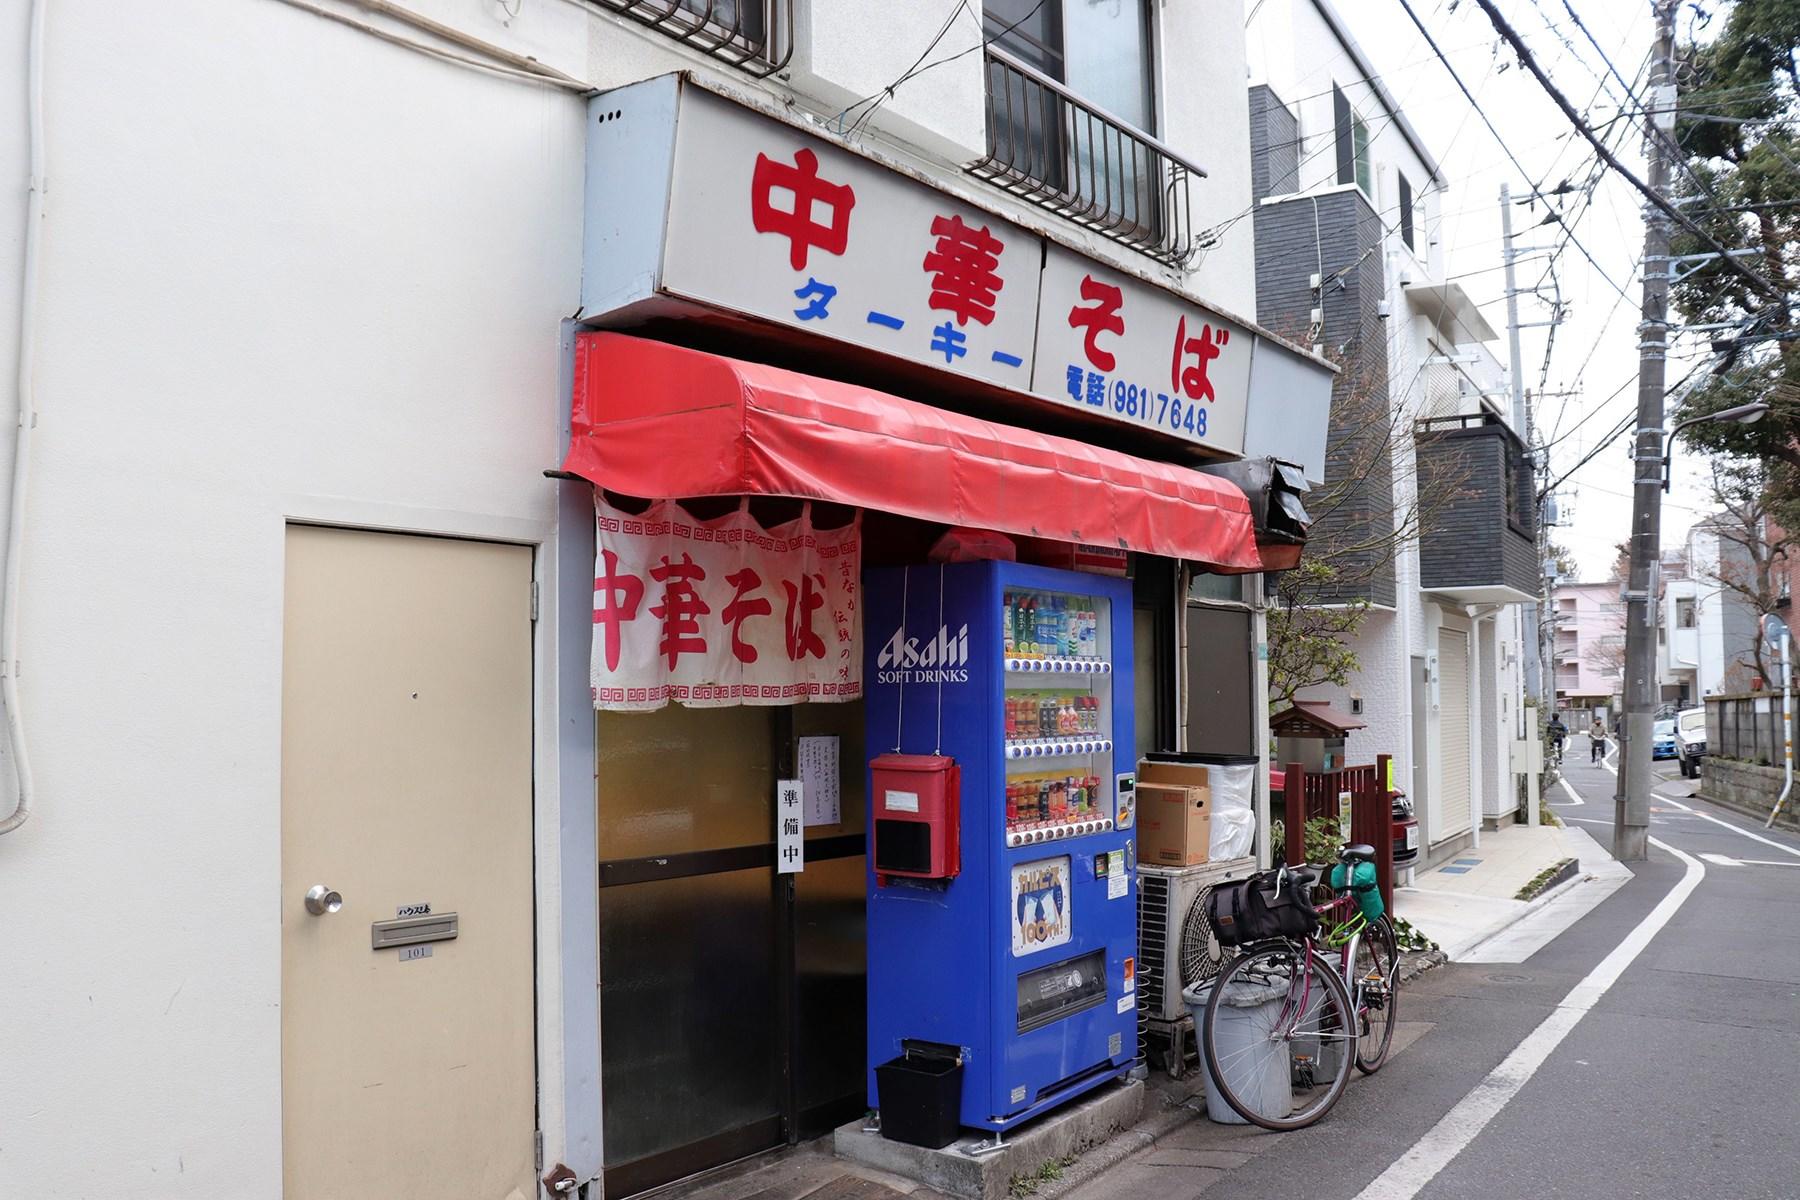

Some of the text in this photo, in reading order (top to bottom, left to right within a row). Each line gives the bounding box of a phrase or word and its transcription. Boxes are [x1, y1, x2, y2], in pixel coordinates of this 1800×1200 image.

[752, 148, 1229, 401] 中華そば
[793, 277, 1023, 368] ターキー
[1067, 364, 1207, 437] 電話(981)7648
[592, 548, 827, 673] 中華そば
[877, 624, 968, 669] Asahi
[878, 669, 968, 684] SOFT DRINKS
[783, 789, 799, 864] 準備中
[407, 947, 425, 959] 101
